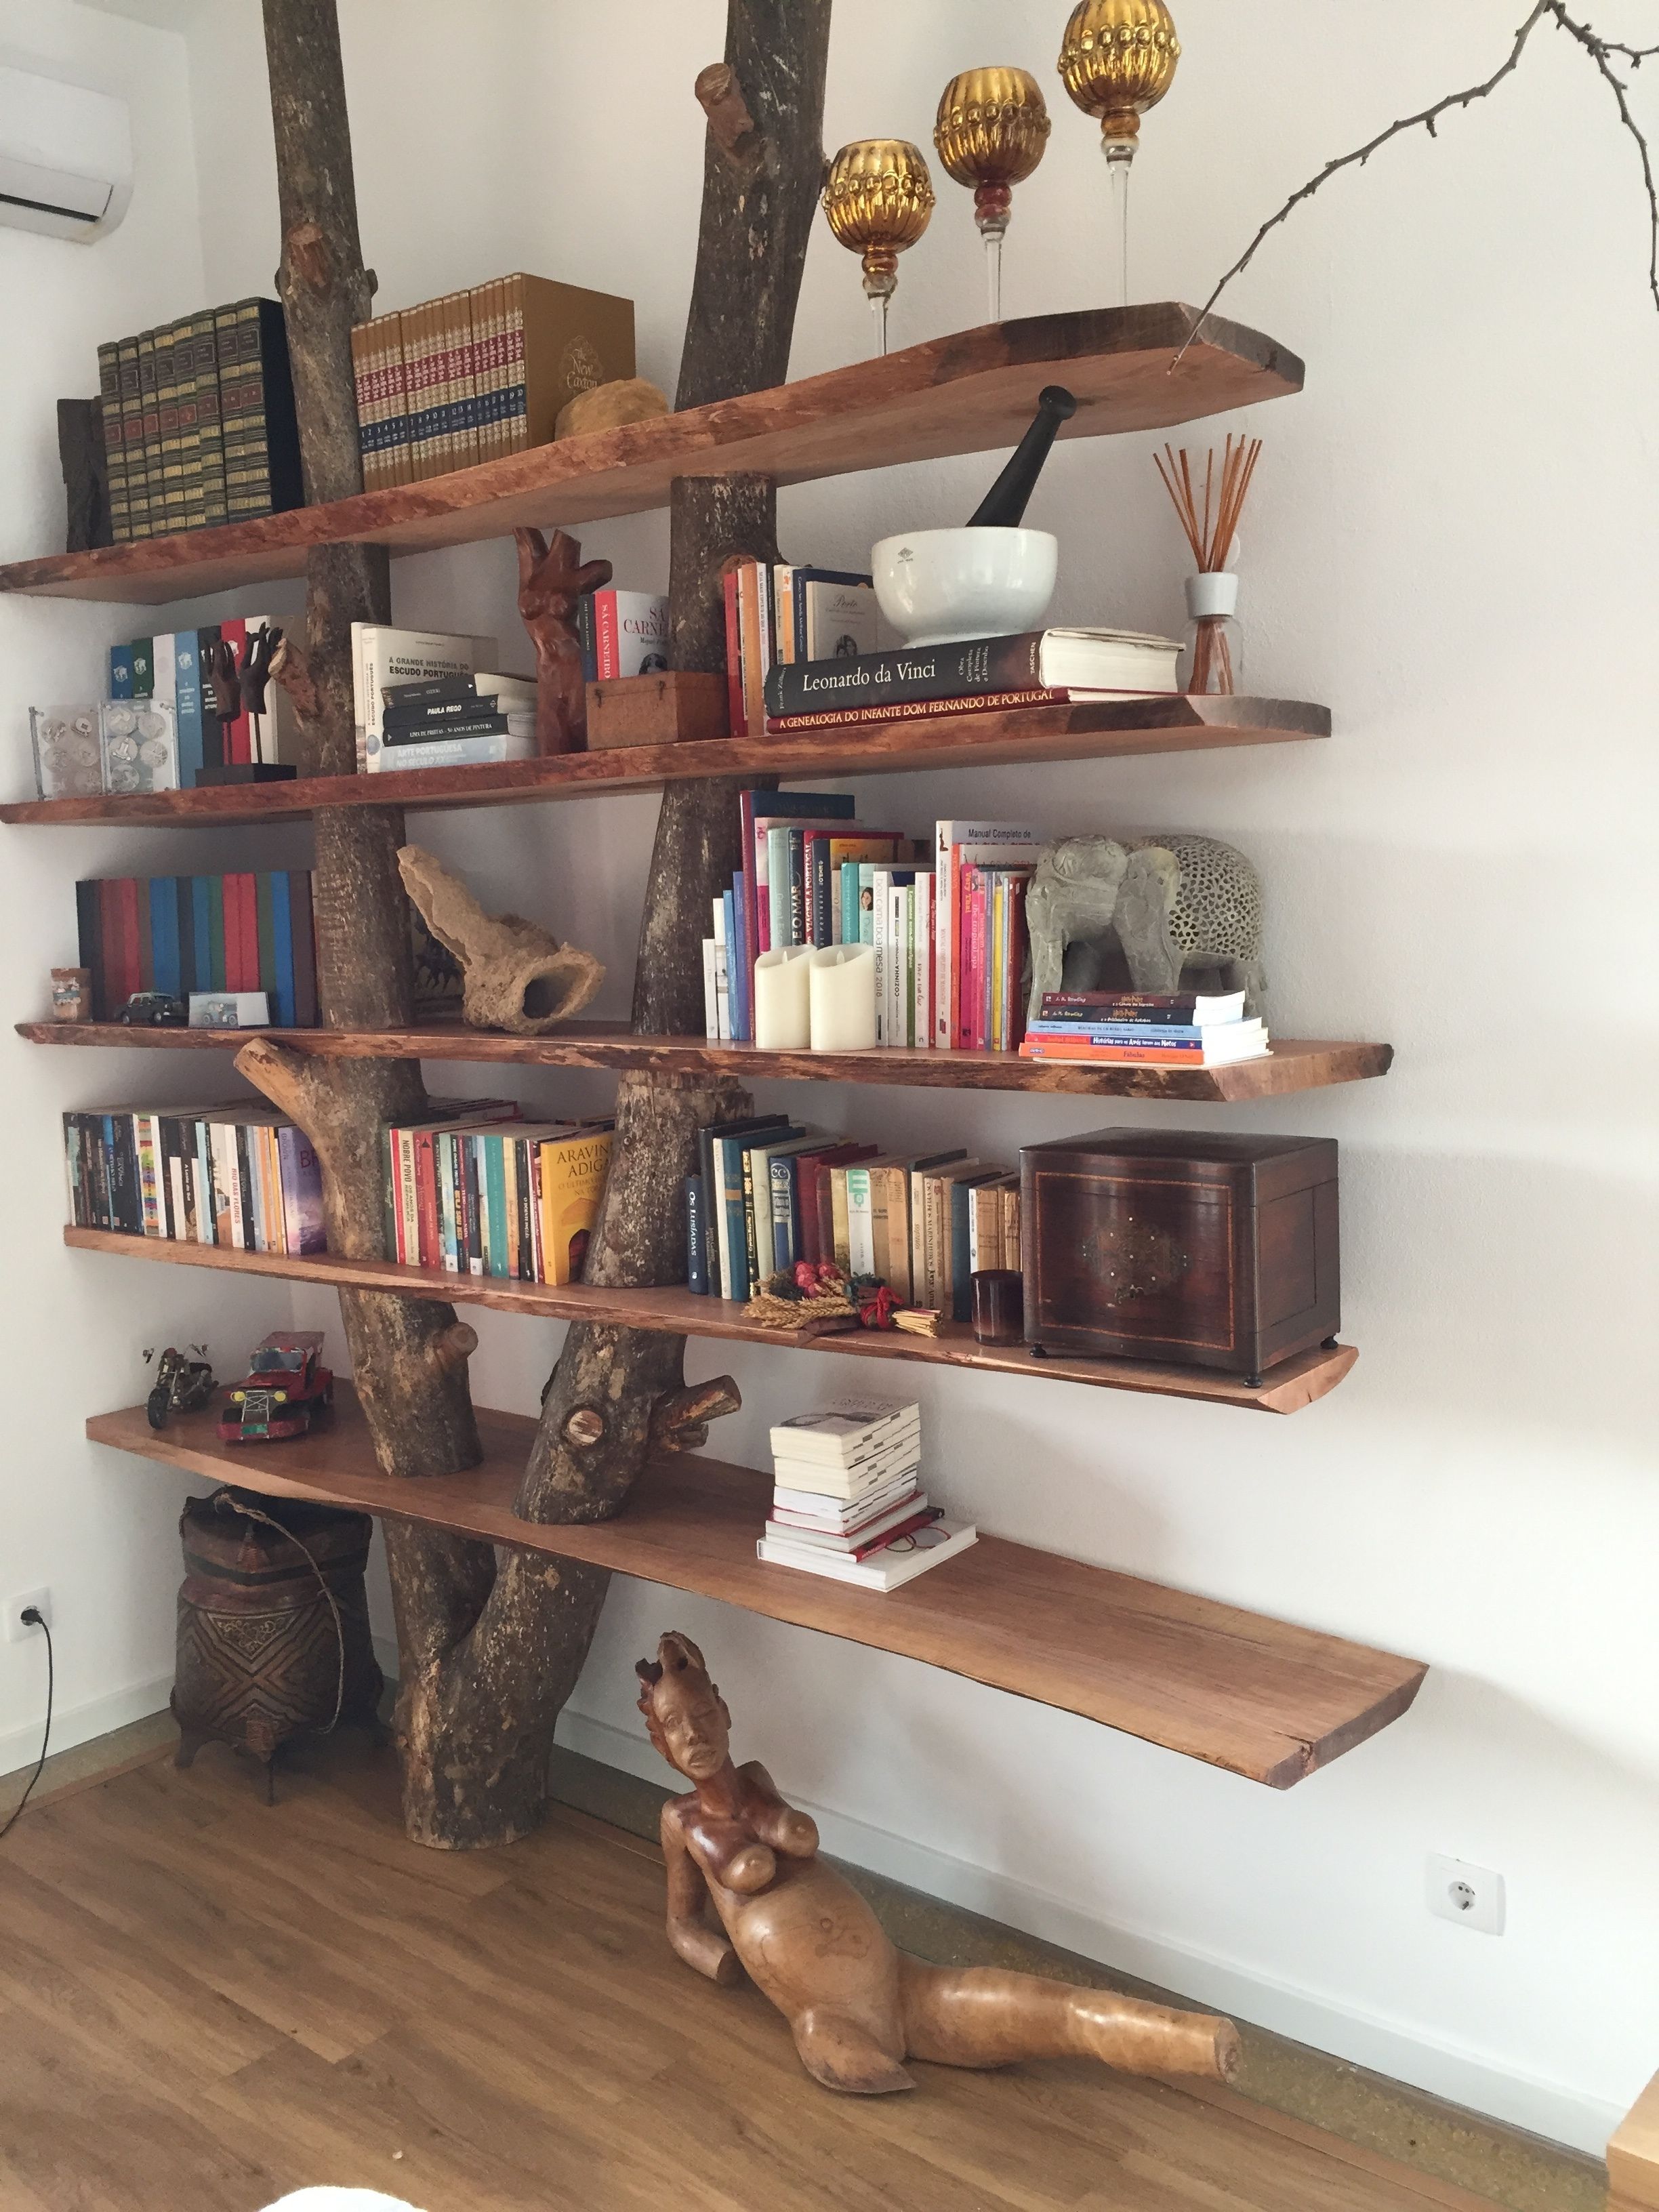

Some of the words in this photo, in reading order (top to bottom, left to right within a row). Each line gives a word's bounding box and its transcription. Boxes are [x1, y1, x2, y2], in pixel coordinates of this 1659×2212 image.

[602, 621, 612, 678] CARNEIRO
[973, 647, 981, 672] Pintura
[1029, 642, 1037, 675] TASCHEN
[389, 665, 421, 676] ESCUDO
[396, 657, 424, 667] GRANDE
[426, 659, 458, 670] HISTÓRIA
[966, 649, 974, 682] Completa
[981, 646, 989, 676] Desenho
[802, 664, 873, 692] Leonardo
[874, 666, 892, 683] da
[897, 658, 937, 680] Vinci
[974, 673, 981, 682] de
[427, 707, 445, 716] PAULA
[445, 704, 462, 714] REGO
[779, 719, 787, 729] A
[787, 713, 842, 728] GENEALOGIA
[844, 712, 859, 722] DO
[861, 706, 901, 720] INFANTE
[903, 703, 926, 716] DOM
[928, 697, 985, 713] FERNANDO
[987, 695, 1000, 706] DE
[1002, 689, 1055, 705] PORTUGAL
[968, 828, 991, 838] Manual
[992, 829, 1022, 840] Completo
[1023, 830, 1031, 839] de
[804, 842, 813, 889] PORTUGAL
[876, 878, 884, 897] boa
[876, 926, 884, 945] boa
[972, 920, 980, 953] tropical
[1092, 1037, 1114, 1046] Histórias
[1128, 1038, 1142, 1046] Avós
[1161, 1040, 1177, 1048] Netos
[403, 1140, 411, 1162] NOBRE
[556, 1141, 613, 1165] ARAVIN
[404, 1164, 412, 1182] POVO
[409, 1185, 413, 1193] OS
[454, 1189, 461, 1209] EU
[410, 1214, 414, 1223] DA
